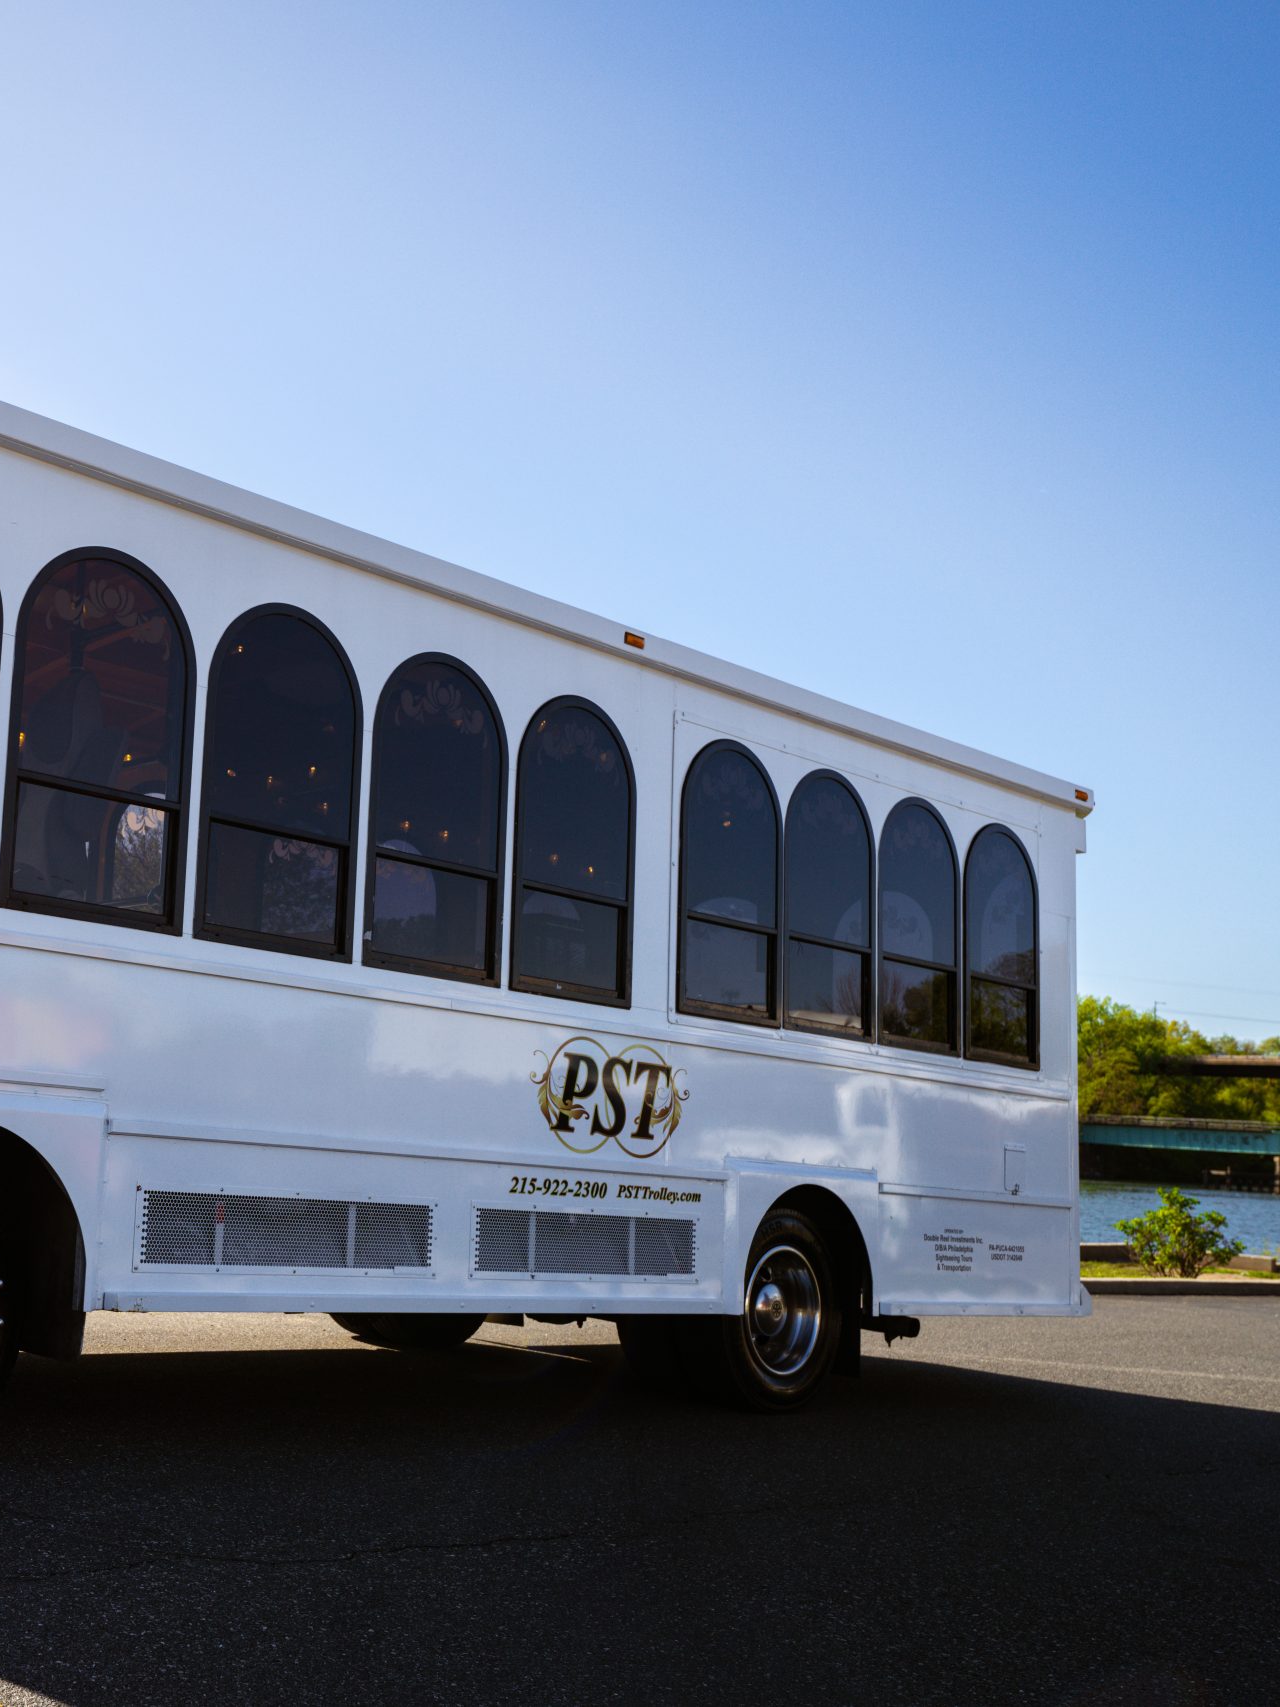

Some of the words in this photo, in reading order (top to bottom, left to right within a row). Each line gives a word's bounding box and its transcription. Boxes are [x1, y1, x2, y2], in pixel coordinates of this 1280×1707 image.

[549, 1051, 673, 1141] PST
[508, 1175, 608, 1200] 215-922-2300
[616, 1183, 702, 1204] PSTTrolley.com
[923, 1233, 940, 1242] Double
[950, 1235, 975, 1244] Investments
[975, 1236, 984, 1244] Inc.
[934, 1244, 948, 1252] D/B/A
[948, 1244, 974, 1253] Philadelphia
[935, 1253, 961, 1263] Sightseeing
[961, 1254, 973, 1263] Tours
[990, 1253, 1006, 1261] USDOT
[936, 1263, 941, 1271] &
[941, 1263, 972, 1272] Transportation
